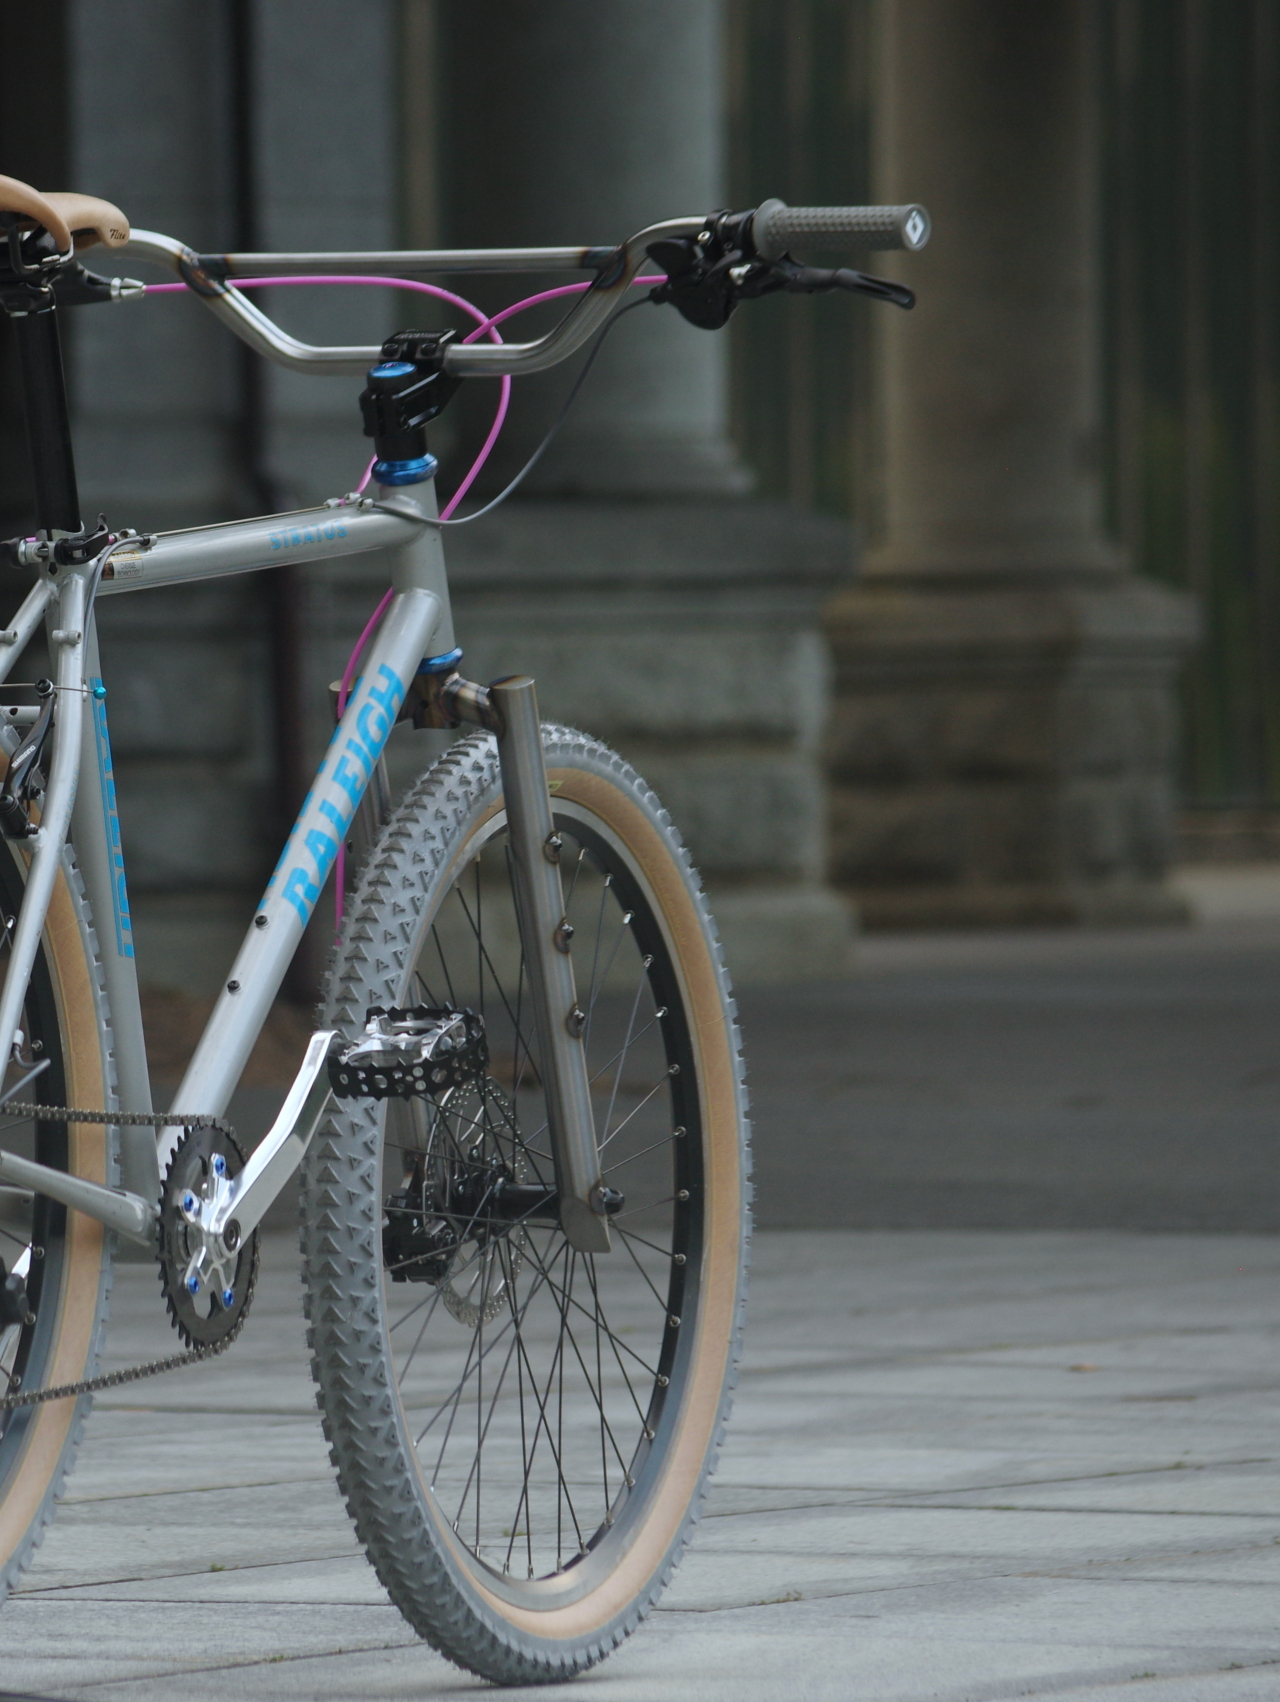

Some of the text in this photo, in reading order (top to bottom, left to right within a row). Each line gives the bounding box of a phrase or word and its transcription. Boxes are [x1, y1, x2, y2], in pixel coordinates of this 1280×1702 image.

[269, 522, 348, 551] STRATUS
[11, 744, 37, 768] SHIMANO
[281, 663, 405, 930] RALEIGH
